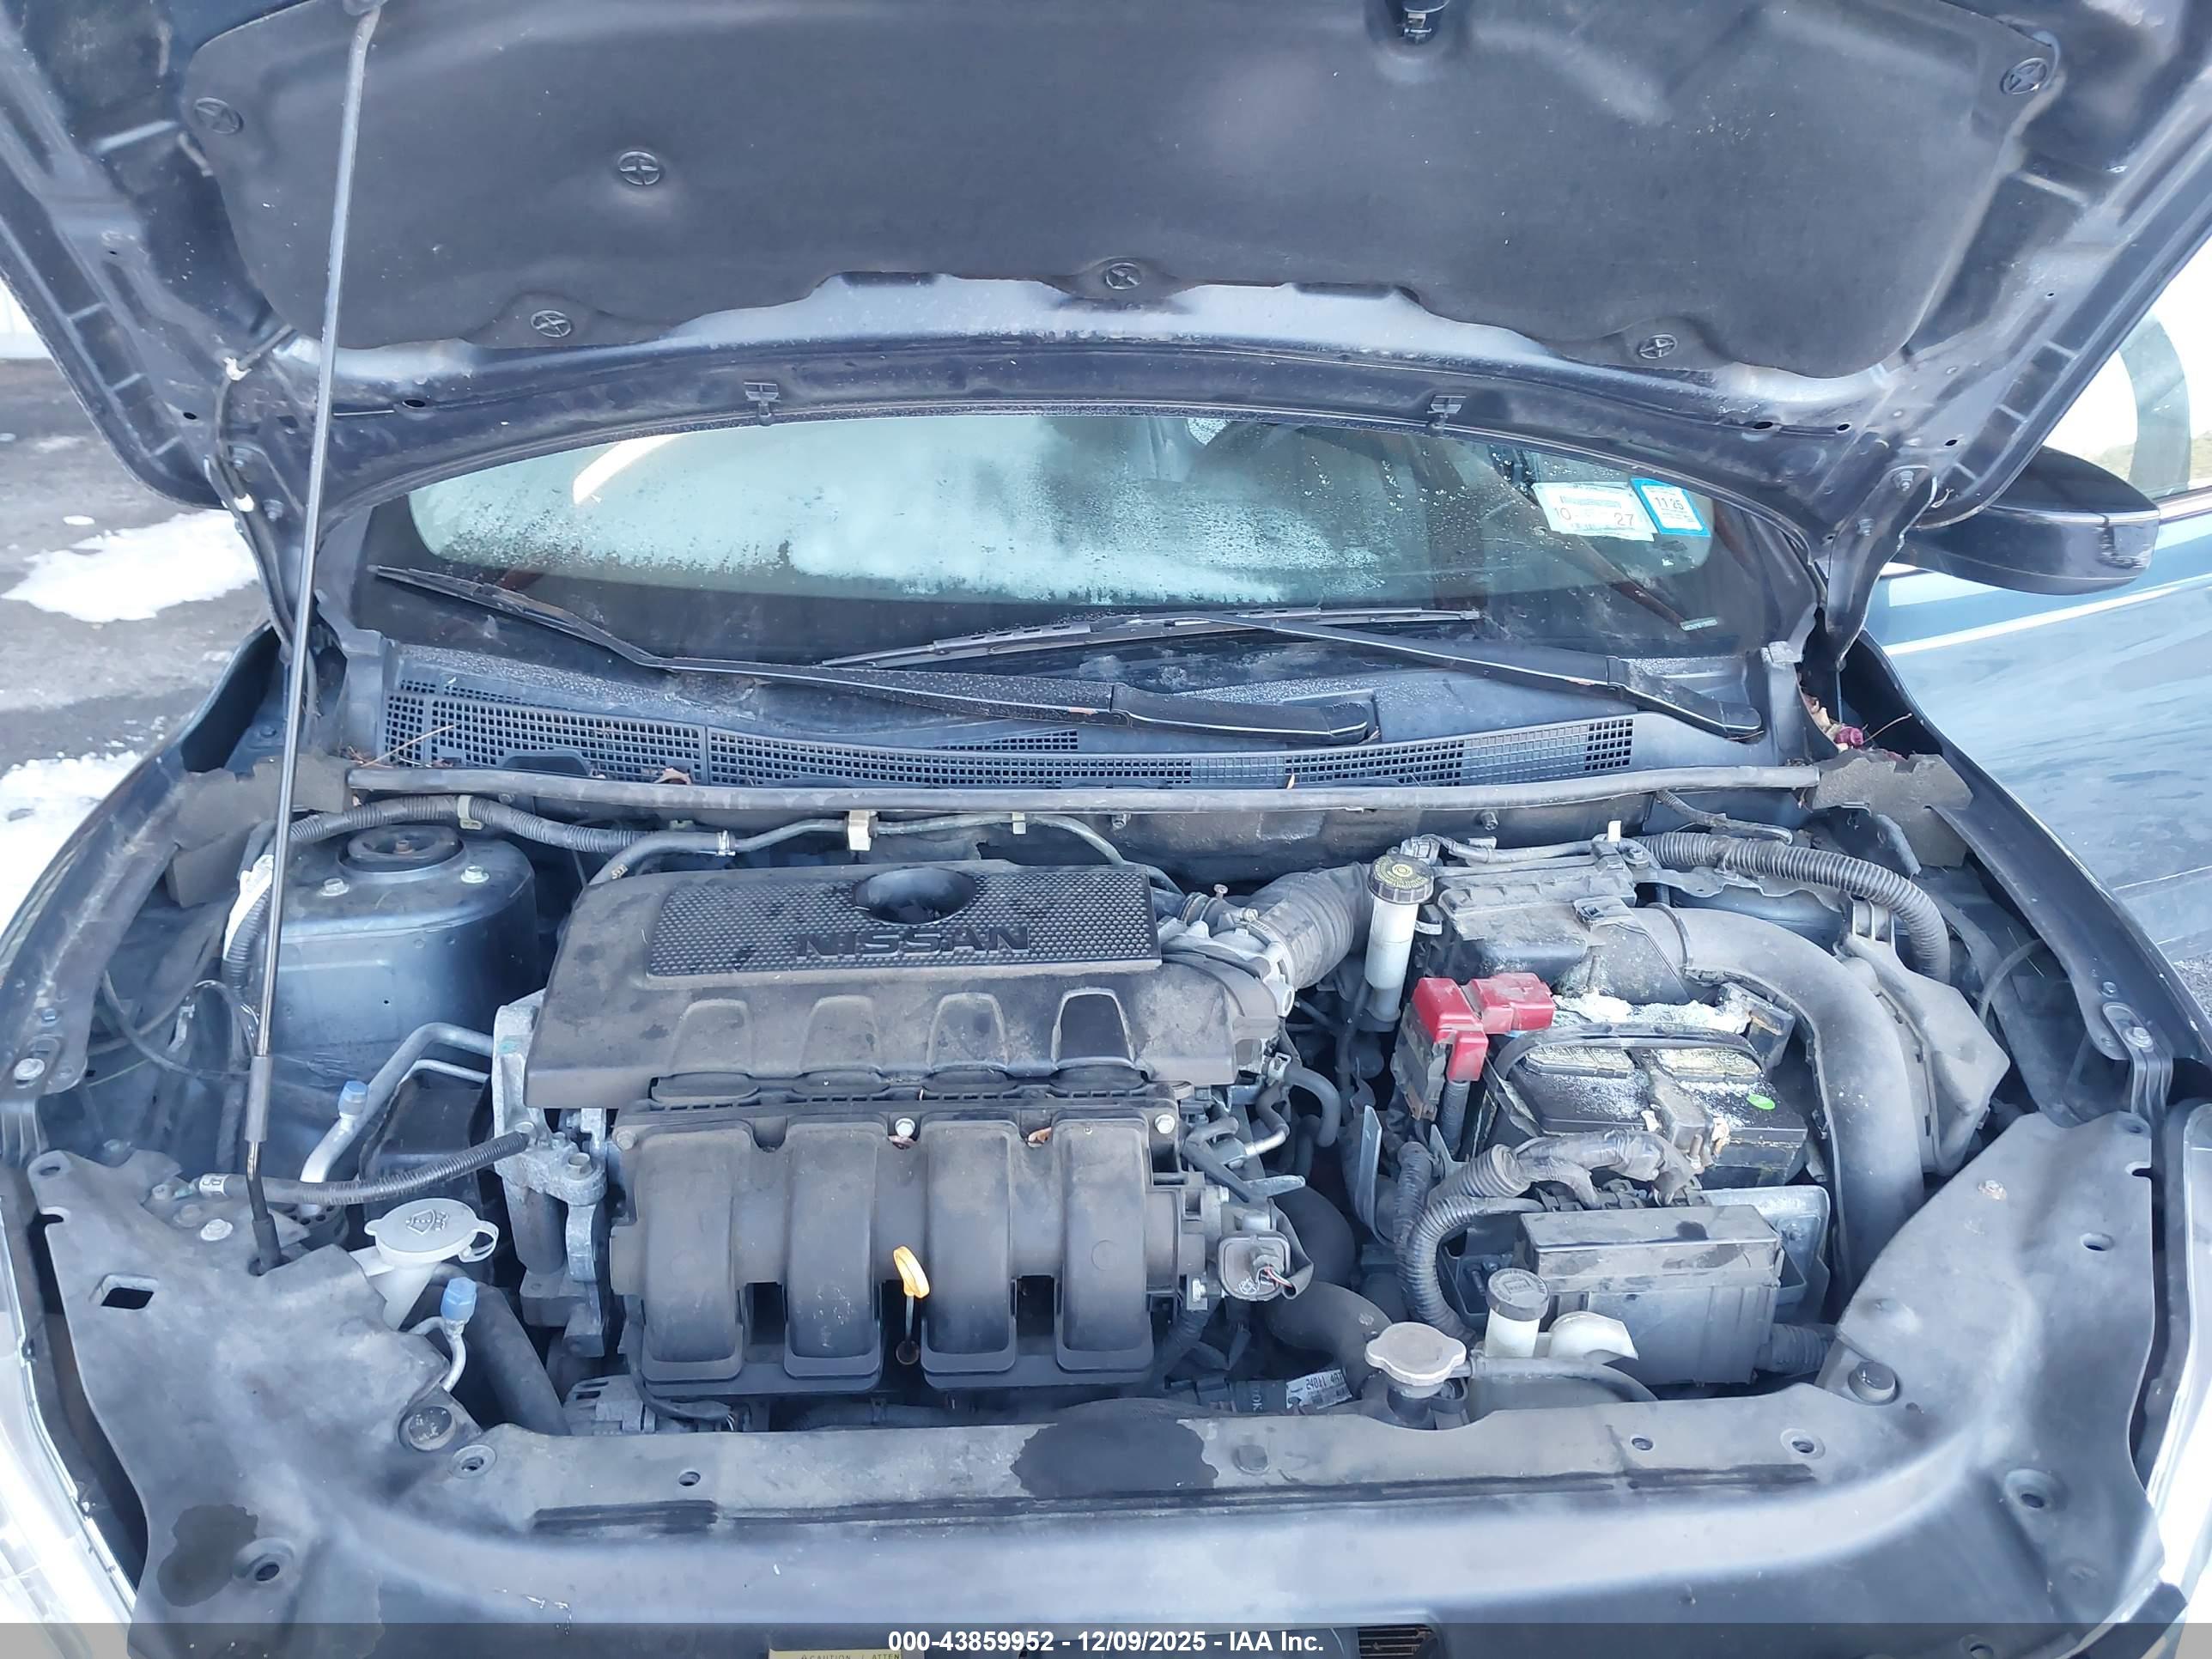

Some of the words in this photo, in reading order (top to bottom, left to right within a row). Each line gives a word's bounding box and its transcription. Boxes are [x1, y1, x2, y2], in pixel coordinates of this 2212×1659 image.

[1655, 496, 1668, 508] 11
[1671, 498, 1685, 511] 25
[1613, 513, 1634, 526] 27
[794, 927, 1030, 960] NISSAN
